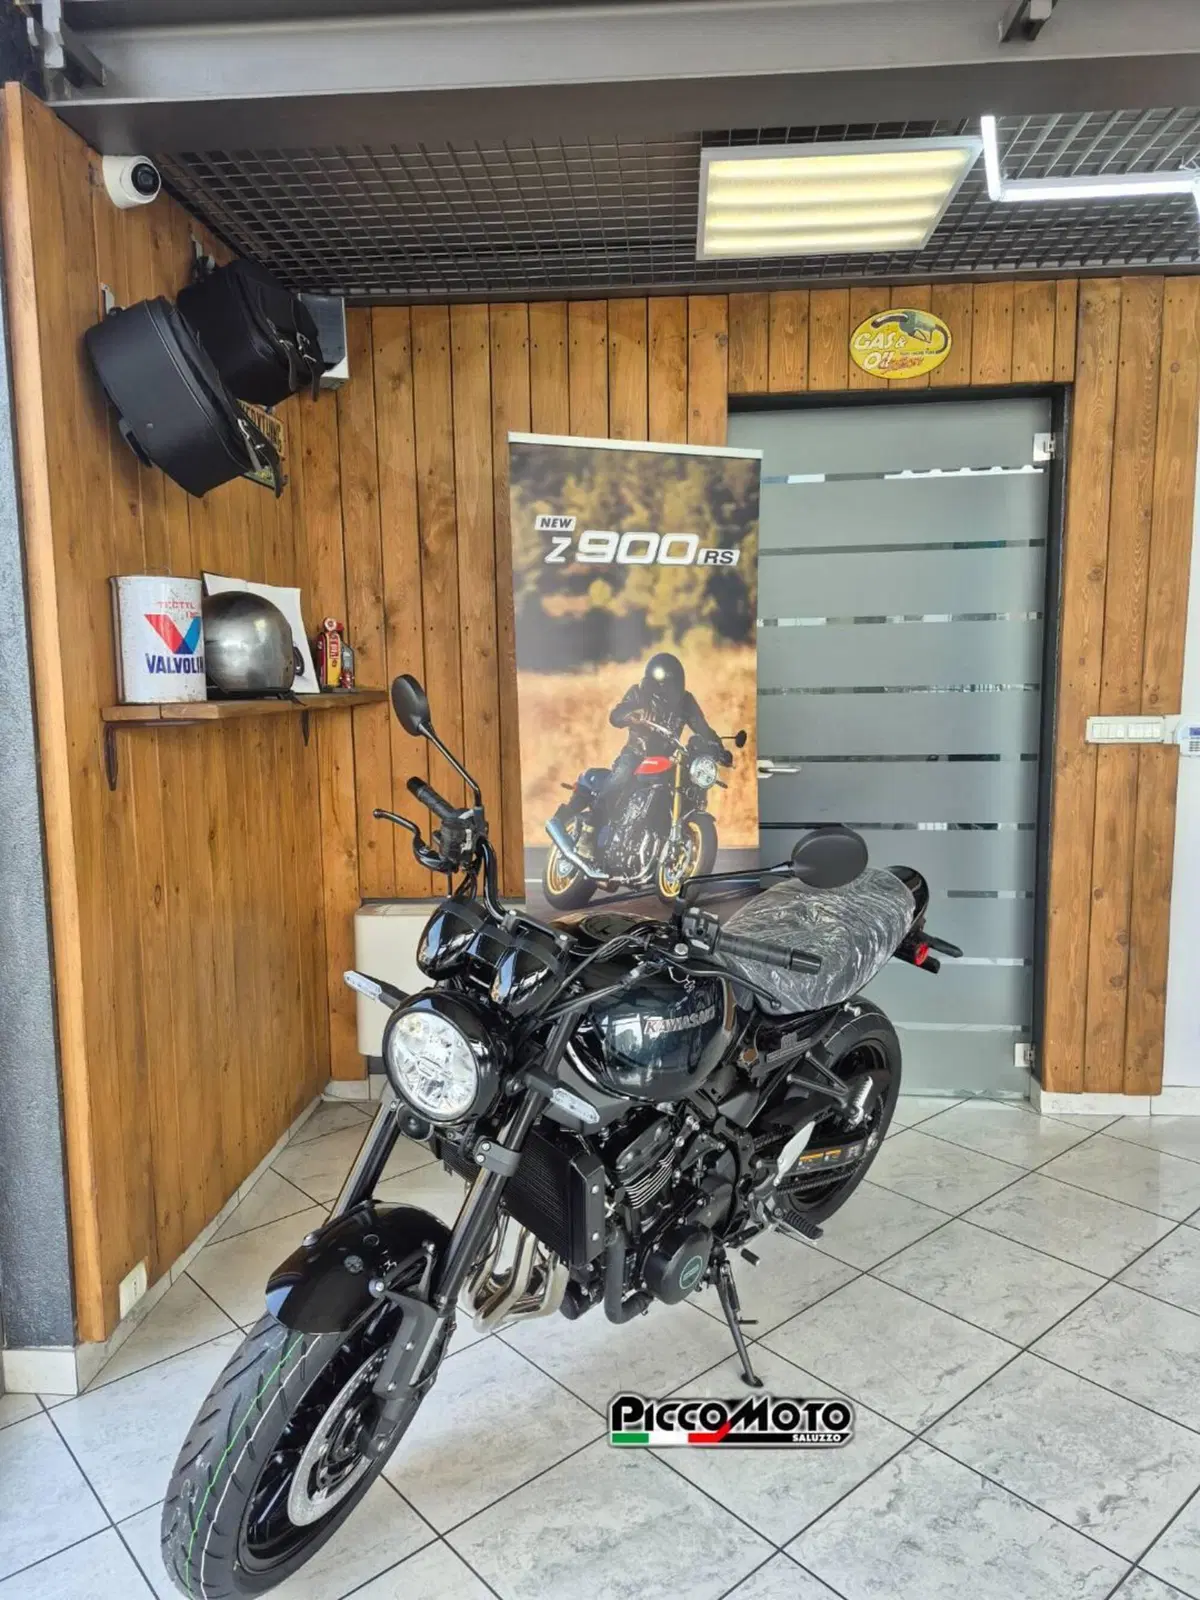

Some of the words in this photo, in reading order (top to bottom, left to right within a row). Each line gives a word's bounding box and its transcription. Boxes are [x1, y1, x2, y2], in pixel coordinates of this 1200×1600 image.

[854, 331, 896, 350] GAS
[894, 335, 907, 349] &
[539, 517, 573, 530] NEW
[703, 550, 734, 565] RS
